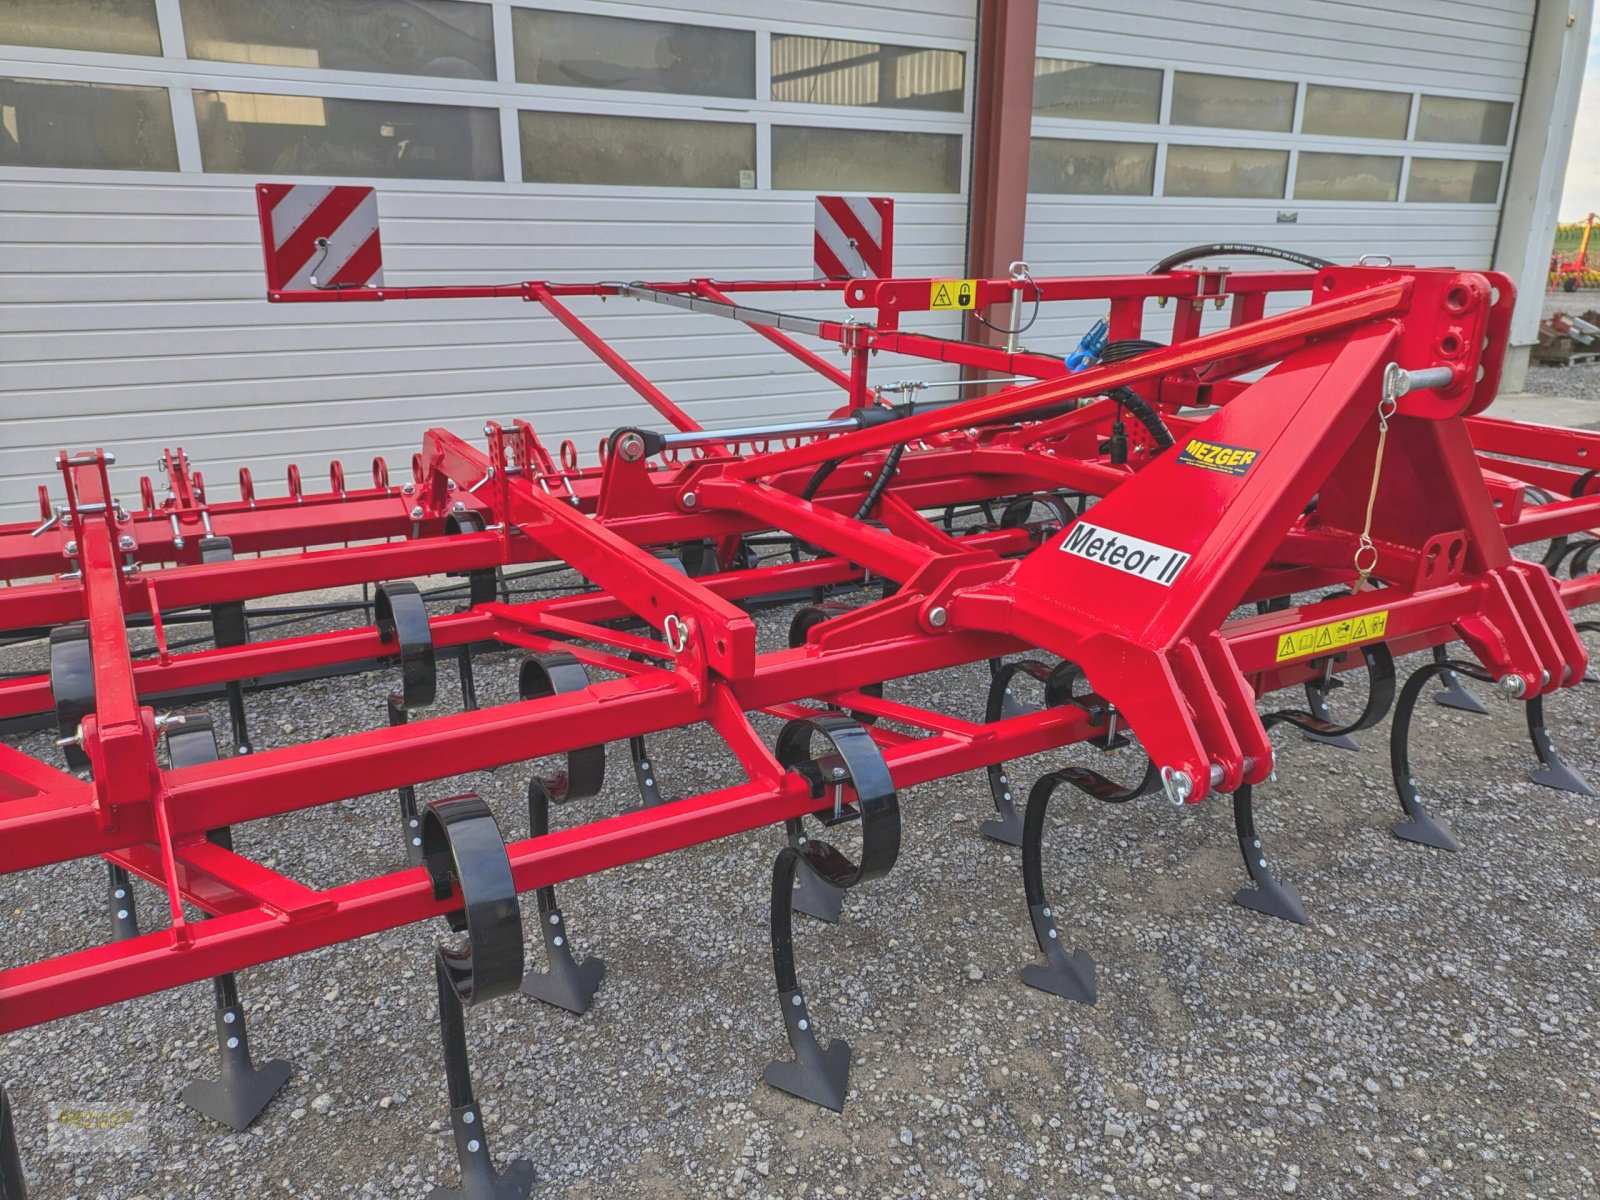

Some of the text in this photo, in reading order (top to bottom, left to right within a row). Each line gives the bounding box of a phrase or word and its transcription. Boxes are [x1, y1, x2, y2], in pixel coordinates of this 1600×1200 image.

[1186, 439, 1256, 466] MEZGER
[1064, 523, 1187, 584] Meteor II
